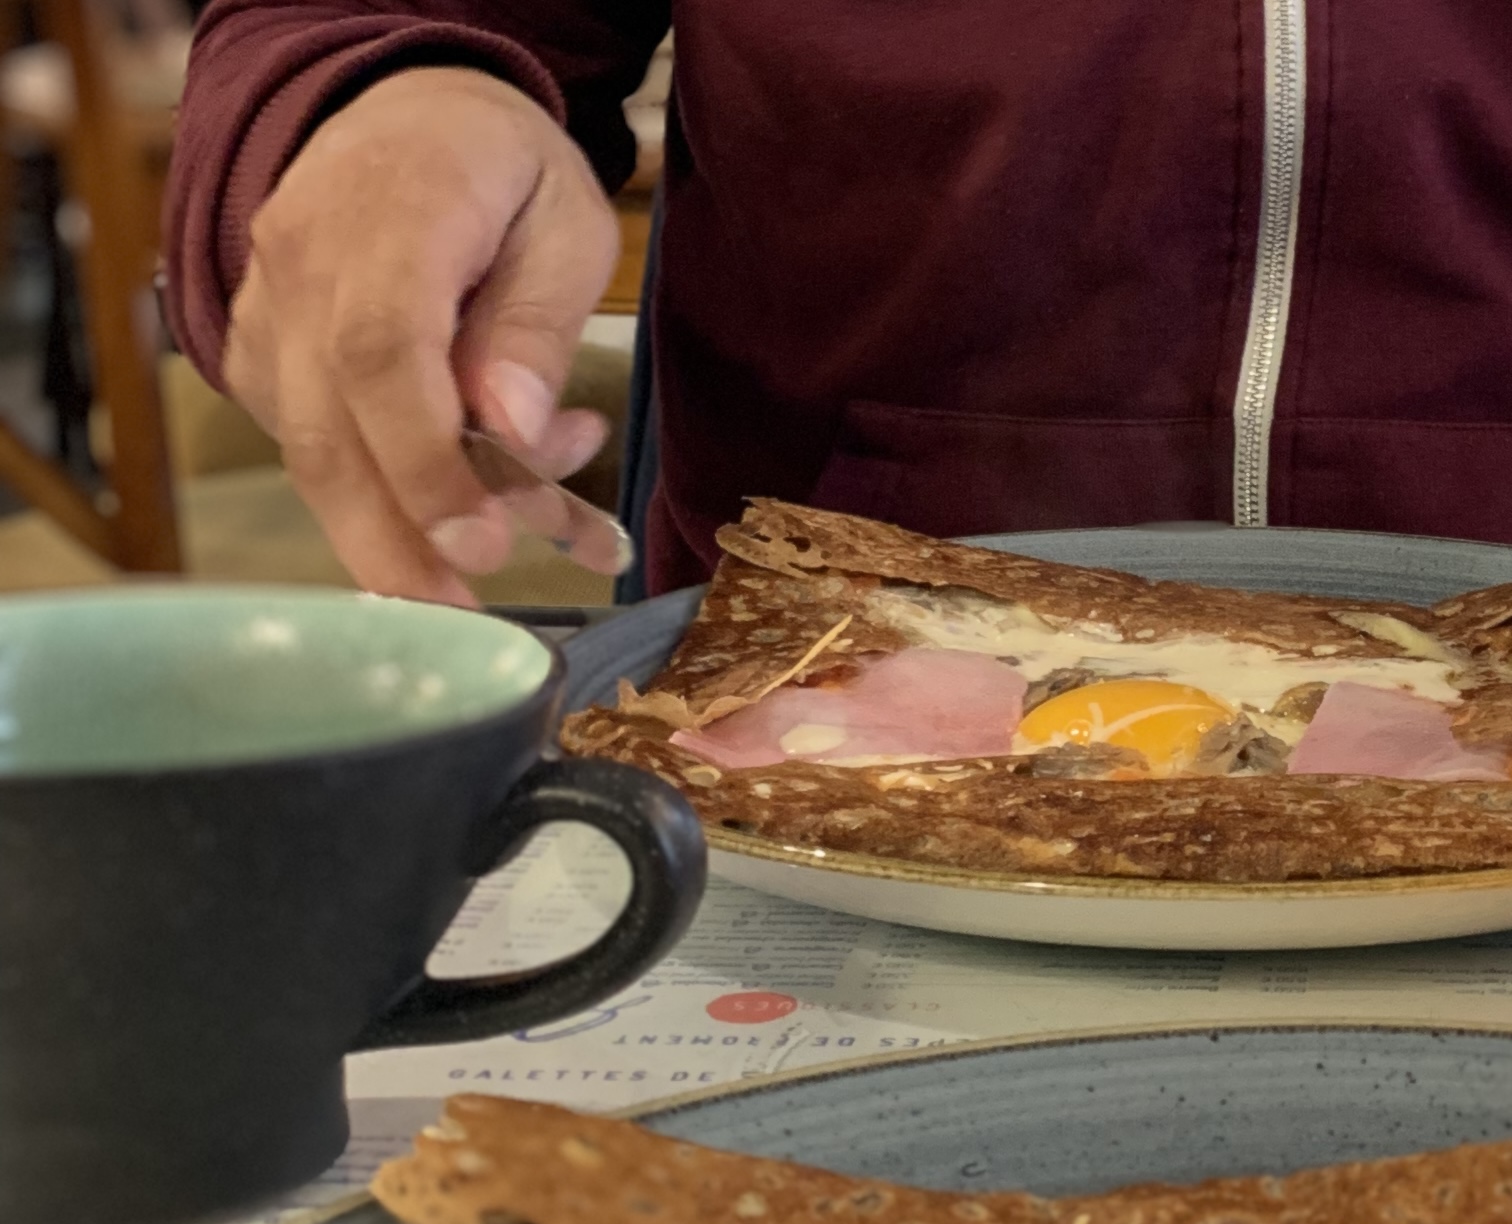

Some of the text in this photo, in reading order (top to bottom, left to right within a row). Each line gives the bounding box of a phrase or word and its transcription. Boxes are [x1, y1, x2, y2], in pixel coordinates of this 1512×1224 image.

[809, 1036, 856, 1047] DE
[448, 1069, 716, 1082] GALETTES DE
